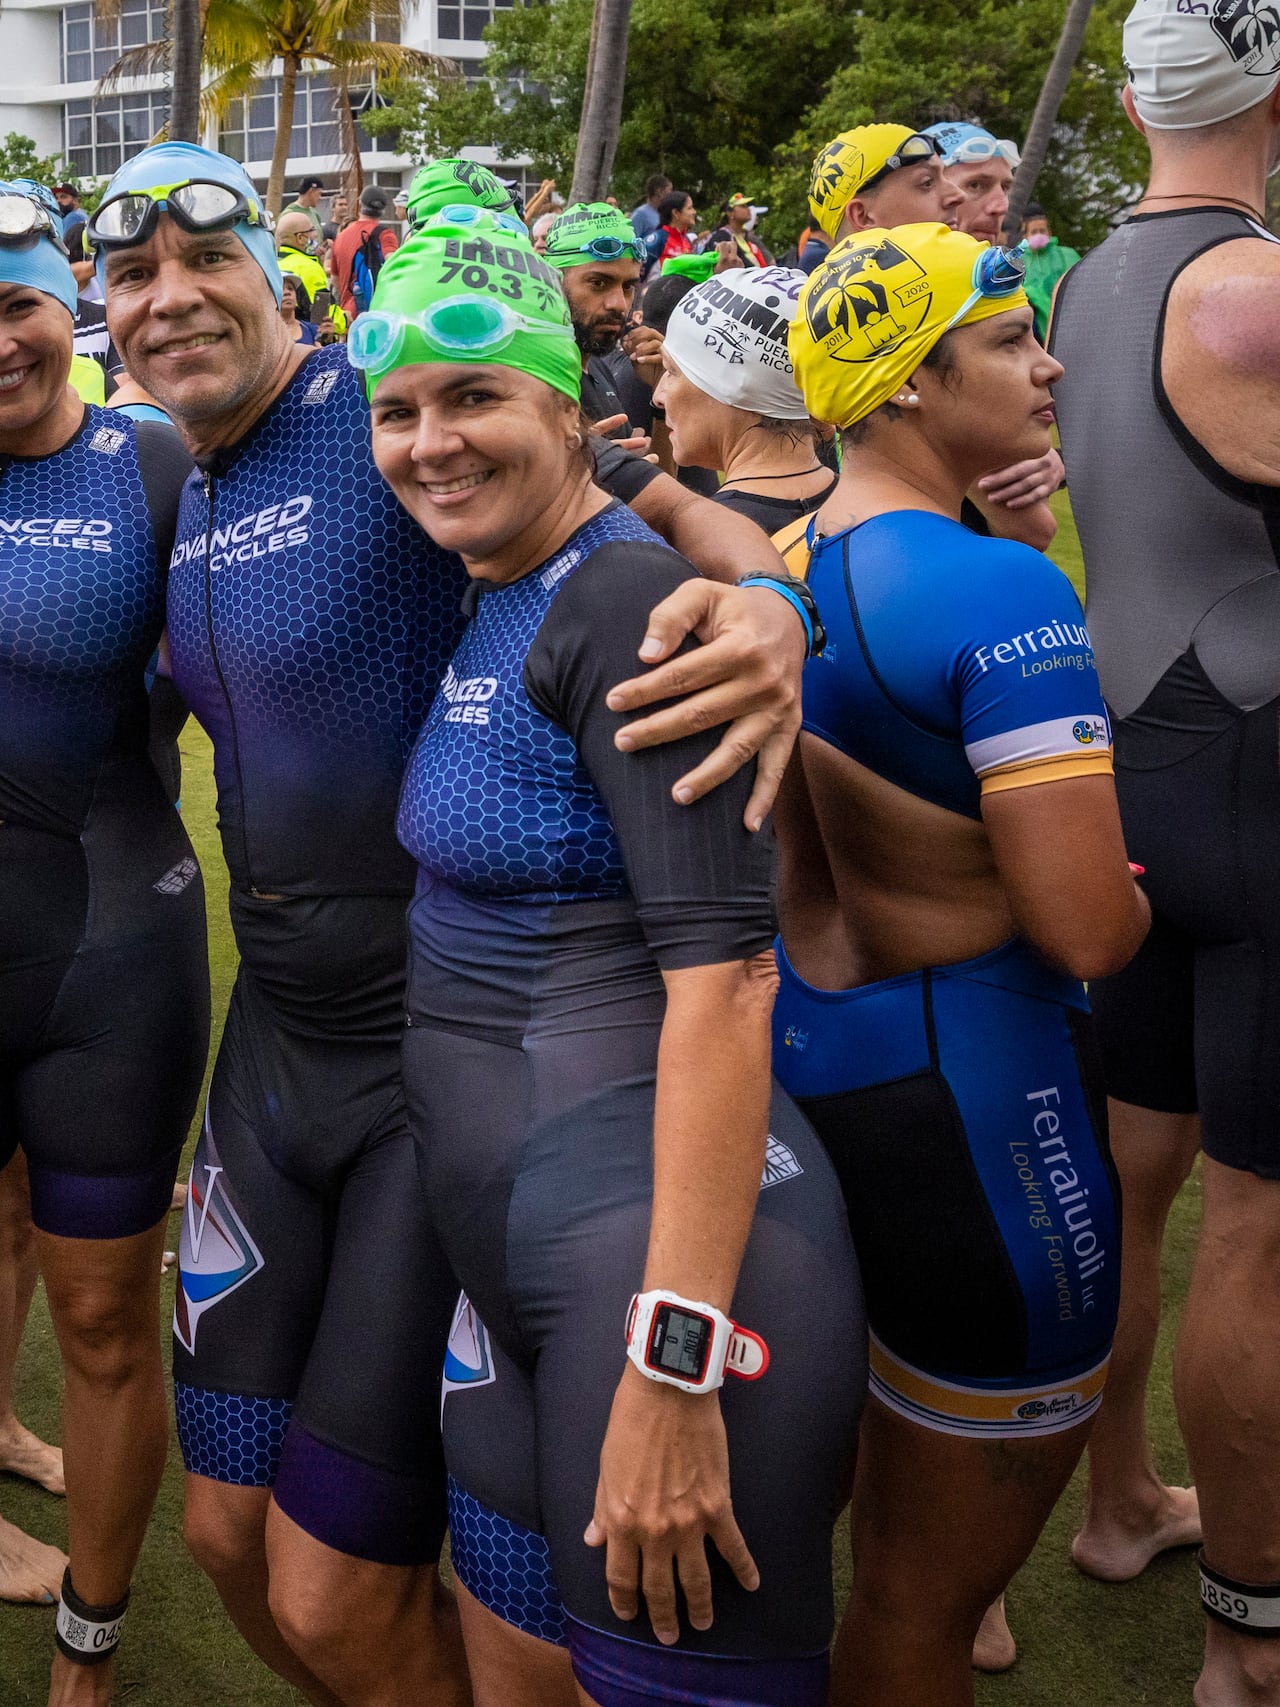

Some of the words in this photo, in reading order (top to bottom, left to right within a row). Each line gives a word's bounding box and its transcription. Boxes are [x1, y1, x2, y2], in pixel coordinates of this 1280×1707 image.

[1243, 51, 1257, 68] 2011
[596, 222, 619, 230] RICO
[437, 261, 523, 299] 70.3
[904, 281, 930, 299] 2020
[824, 332, 843, 351] 2011
[759, 352, 794, 374] RICO
[209, 524, 309, 572] CYCLES
[1021, 653, 1085, 678] Looking
[1026, 1086, 1105, 1280] Ferraiuoli
[1009, 1141, 1053, 1229] Looking
[1040, 1234, 1077, 1322] Forward
